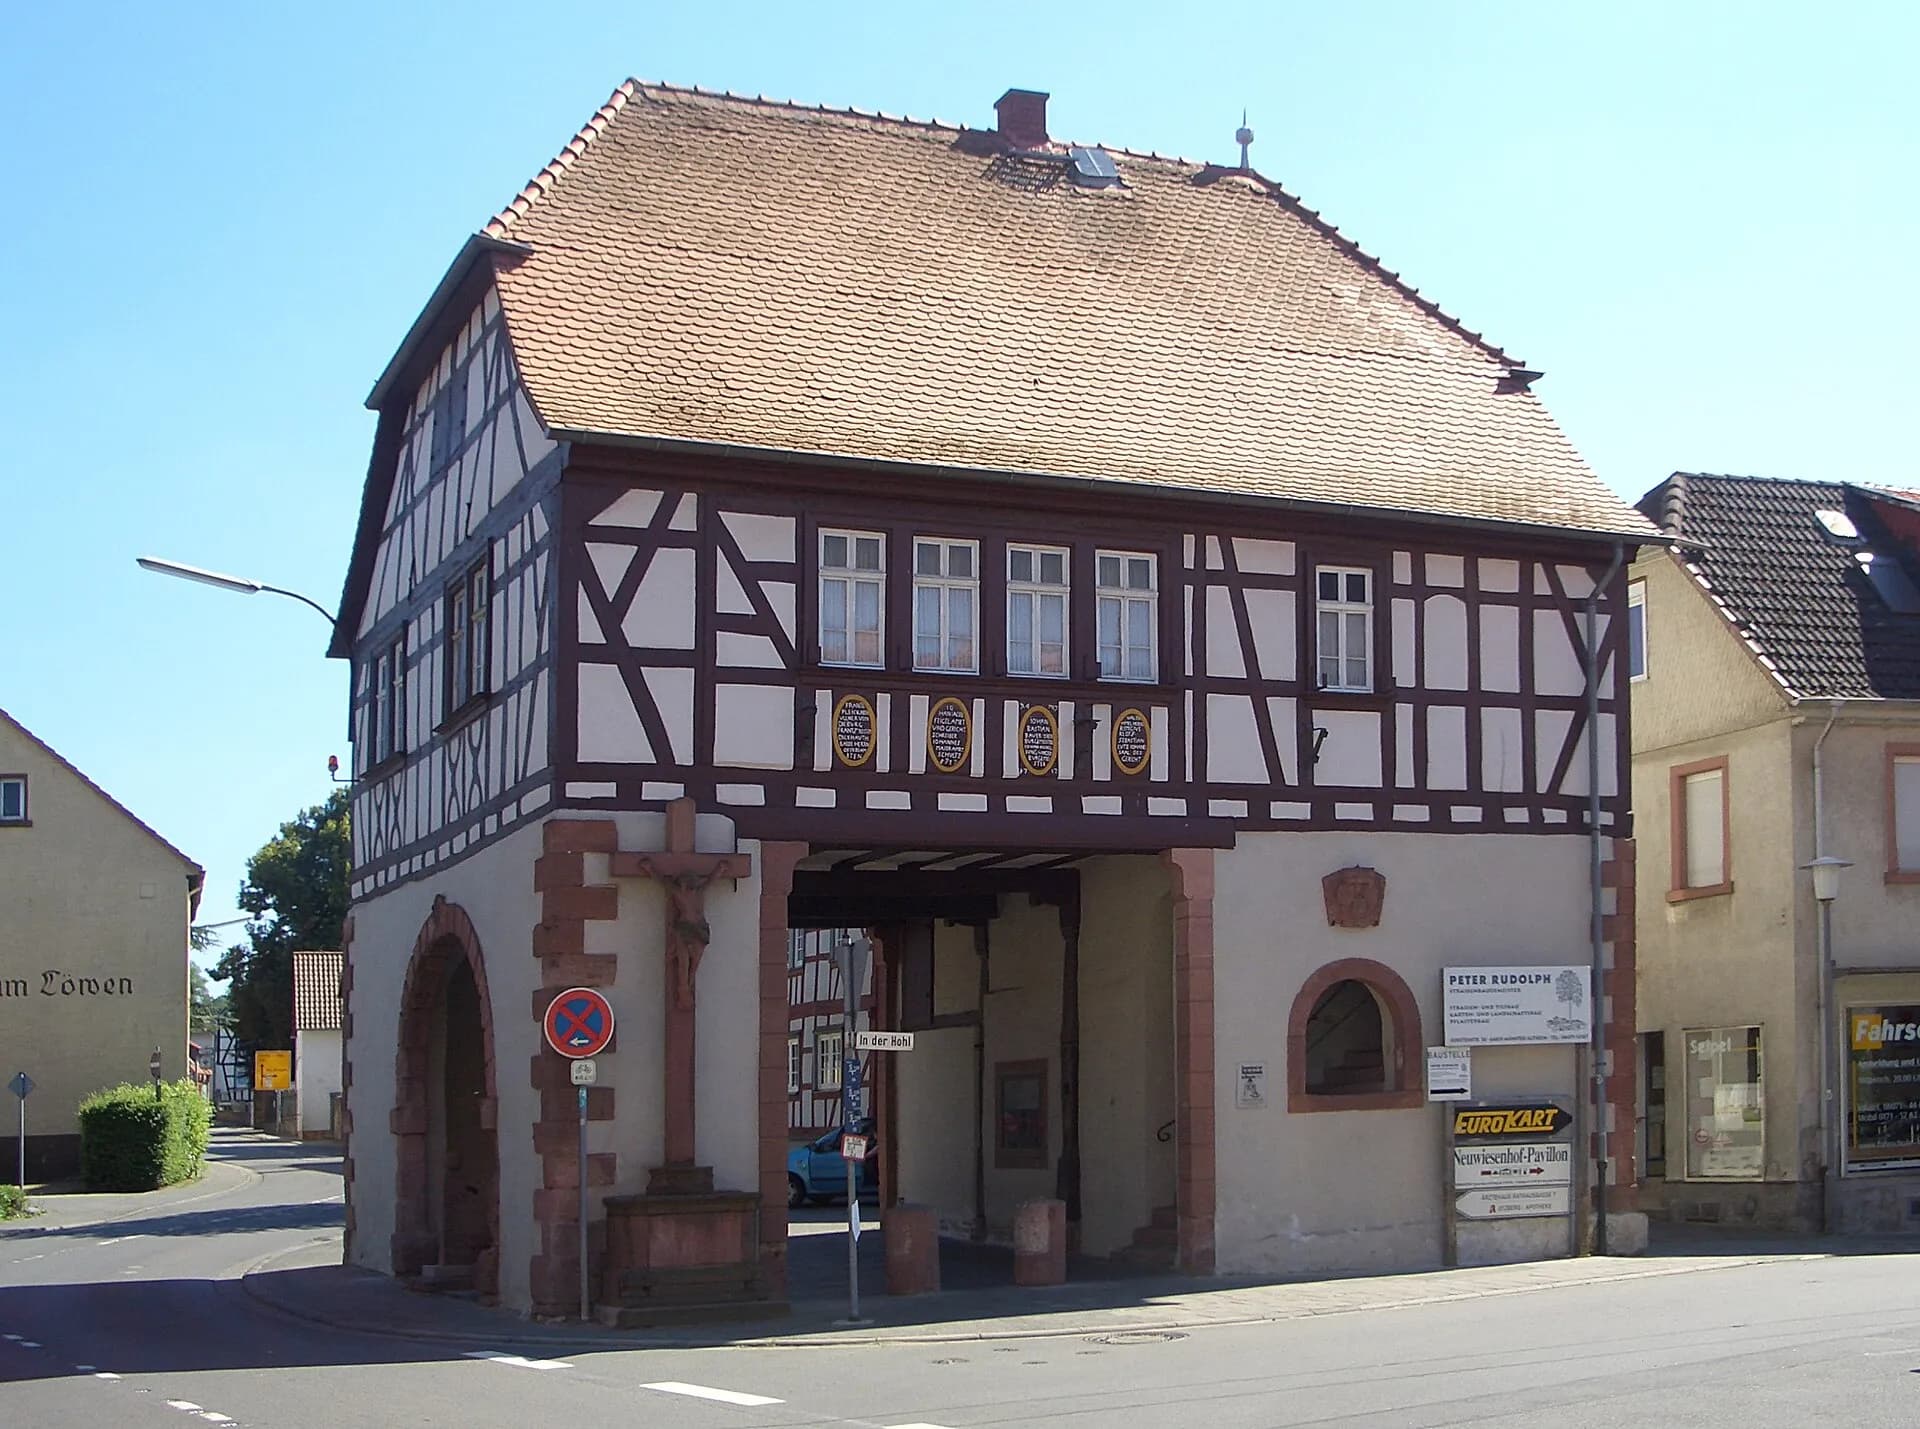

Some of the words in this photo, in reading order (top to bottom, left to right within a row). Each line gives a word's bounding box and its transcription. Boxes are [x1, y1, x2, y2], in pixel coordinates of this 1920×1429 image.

[40, 969, 133, 996] Löwen
[1449, 975, 1487, 985] PETER
[1491, 974, 1550, 985] RUDOLPH
[859, 1035, 868, 1045] In
[871, 1035, 888, 1046] der
[891, 1035, 911, 1046] Hohl
[1454, 1147, 1568, 1165] Neuwiesenhof-Pavillon
